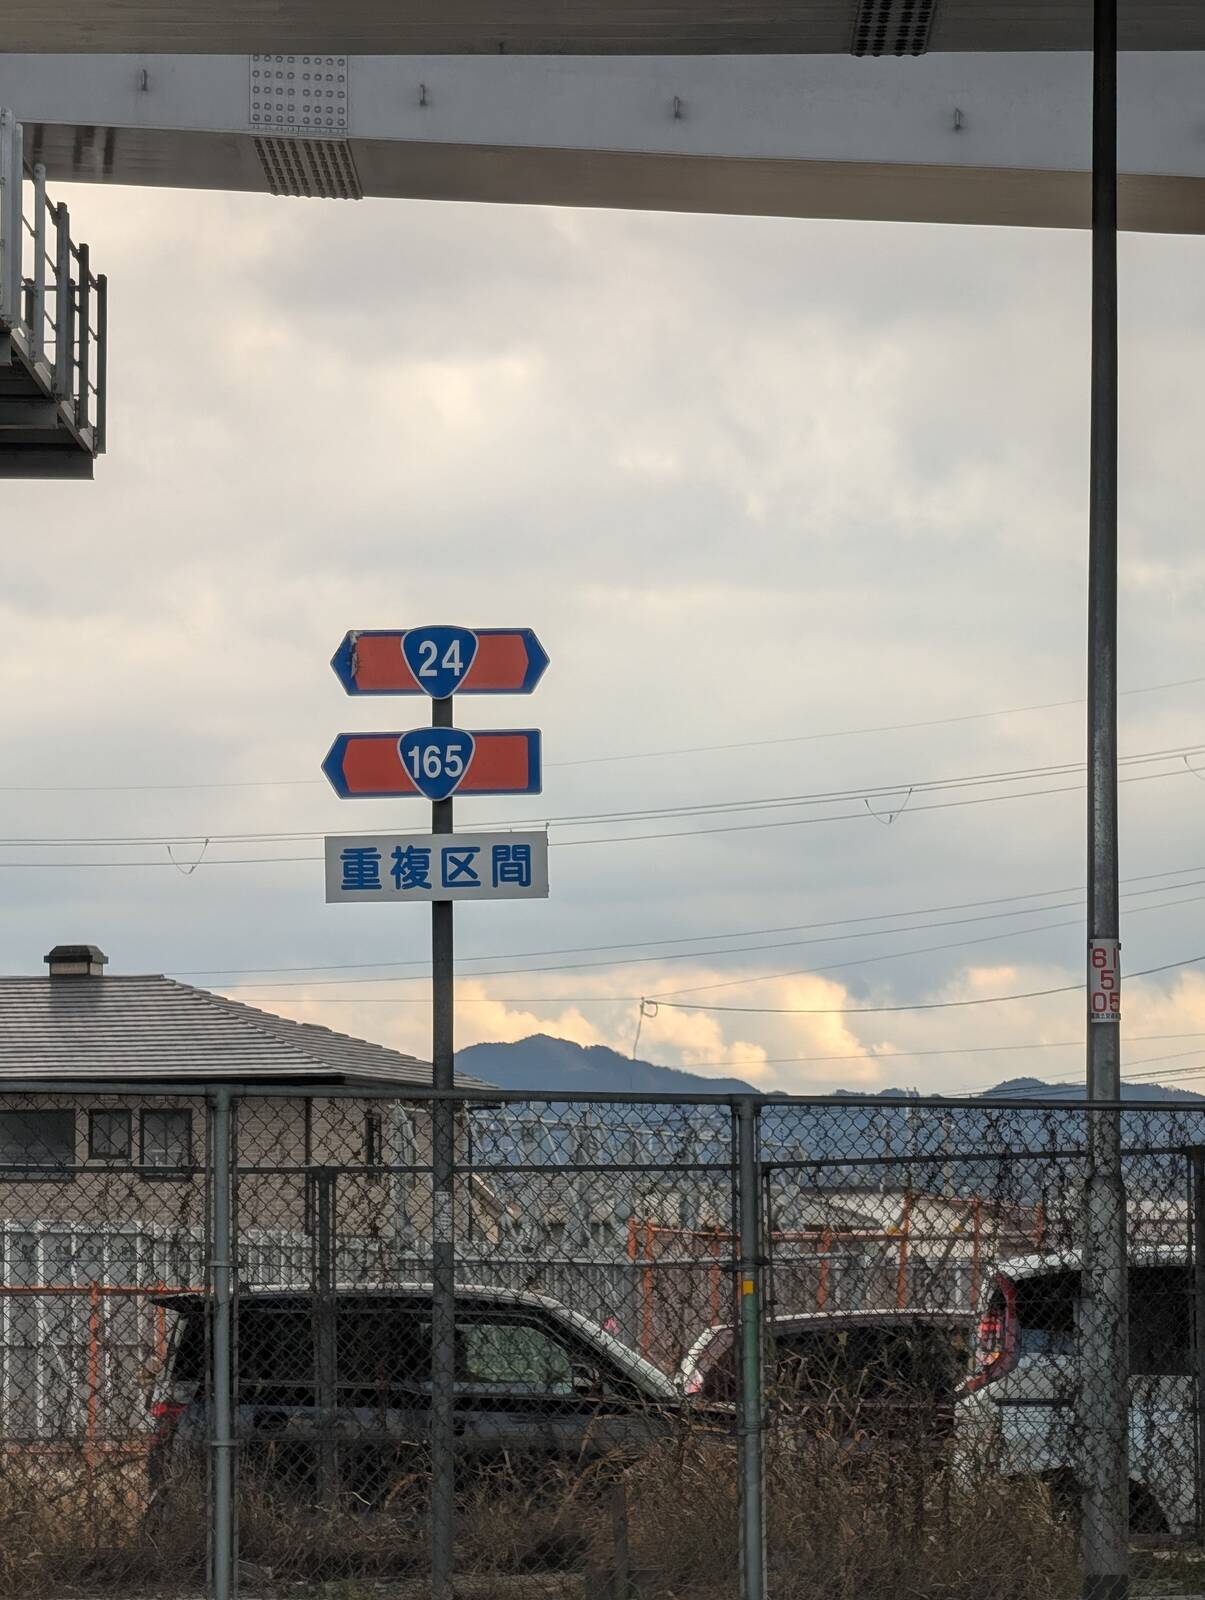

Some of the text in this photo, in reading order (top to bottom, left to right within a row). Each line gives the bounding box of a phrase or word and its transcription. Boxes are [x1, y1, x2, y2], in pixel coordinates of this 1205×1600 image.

[418, 639, 464, 677] 24
[408, 745, 464, 779] 165
[339, 844, 532, 890] 重複区間
[1100, 969, 1115, 991] 5
